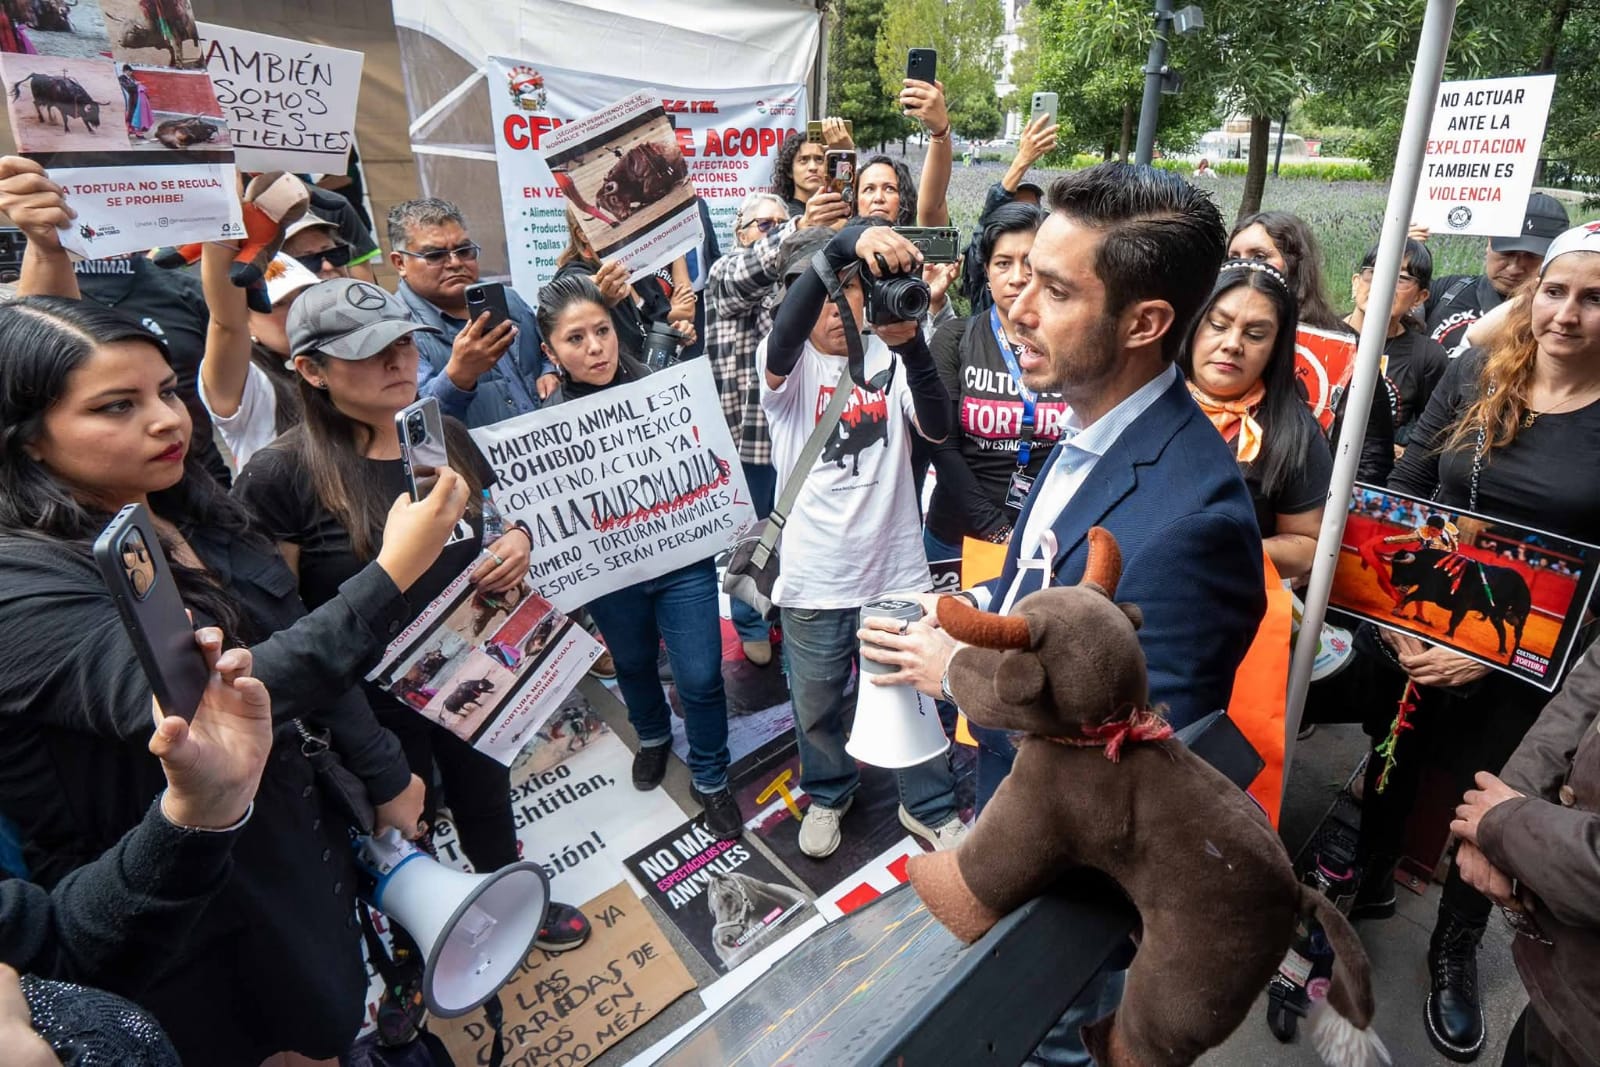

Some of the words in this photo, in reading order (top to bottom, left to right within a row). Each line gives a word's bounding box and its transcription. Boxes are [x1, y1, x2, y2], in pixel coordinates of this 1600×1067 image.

[200, 39, 332, 86] AMBIÉN
[213, 79, 328, 115] SOMOS
[1440, 92, 1460, 108] NO
[1463, 88, 1525, 107] ACTUAR
[220, 105, 307, 132] RES
[1447, 114, 1487, 131] ANTE
[1490, 114, 1510, 130] LA
[231, 128, 350, 150] TIENTES
[675, 127, 697, 158] E
[1425, 138, 1527, 155] EXPLOTACION
[690, 172, 738, 184] ACIONES
[691, 160, 750, 171] AFECTADOS
[1428, 162, 1491, 178] TAMBIEN
[1494, 162, 1514, 178] ES
[73, 180, 136, 196] TORTURA
[139, 180, 158, 192] NO
[161, 179, 175, 191] SE
[178, 177, 222, 190] REGULA,
[106, 196, 123, 208] SE
[125, 193, 184, 206] PROHIBE!
[523, 186, 542, 198] EN
[695, 185, 746, 199] ERÉTARO
[1429, 186, 1501, 202] VIOLENCIA
[532, 239, 561, 251] Toallas
[616, 252, 635, 267] OTEN
[74, 259, 136, 275] ANIMAL
[1430, 308, 1477, 340] FUCK
[964, 365, 1019, 397] CULTU
[487, 421, 573, 466] MALTRATO
[577, 399, 645, 437] ANIMAL
[646, 374, 691, 413] ESTÁ
[966, 401, 1064, 438] TORTUR
[494, 439, 597, 491] ROHIBIDO
[598, 429, 624, 453] EN
[627, 406, 692, 445] MÉXICO
[664, 425, 702, 455] YA!
[536, 512, 558, 548] A
[551, 498, 592, 540] LA
[582, 447, 730, 525] TAUROMAQUIA
[528, 545, 583, 580] RIMERO
[588, 516, 667, 556] TORTURAN
[670, 490, 731, 529] ANIMALES
[538, 561, 600, 599] ESPUÉS
[603, 544, 654, 572] SERÁN
[657, 512, 734, 552] PERSONAS
[391, 610, 432, 649] TORTURA
[429, 598, 441, 610] SE
[1515, 655, 1545, 673] TORTURA
[500, 693, 532, 729] TORTURA
[530, 680, 543, 693] NO
[541, 669, 551, 680] SE
[520, 704, 531, 717] SE
[509, 764, 572, 804] exico
[512, 773, 616, 830] chtitlan,
[541, 830, 607, 880] sión!
[638, 848, 680, 883] NO
[656, 845, 721, 893] ESPECTÁCULOS
[594, 904, 626, 929] YA
[626, 941, 660, 969] DE
[463, 1021, 486, 1043] D
[504, 1023, 575, 1067] OROS
[594, 980, 636, 1018] EN
